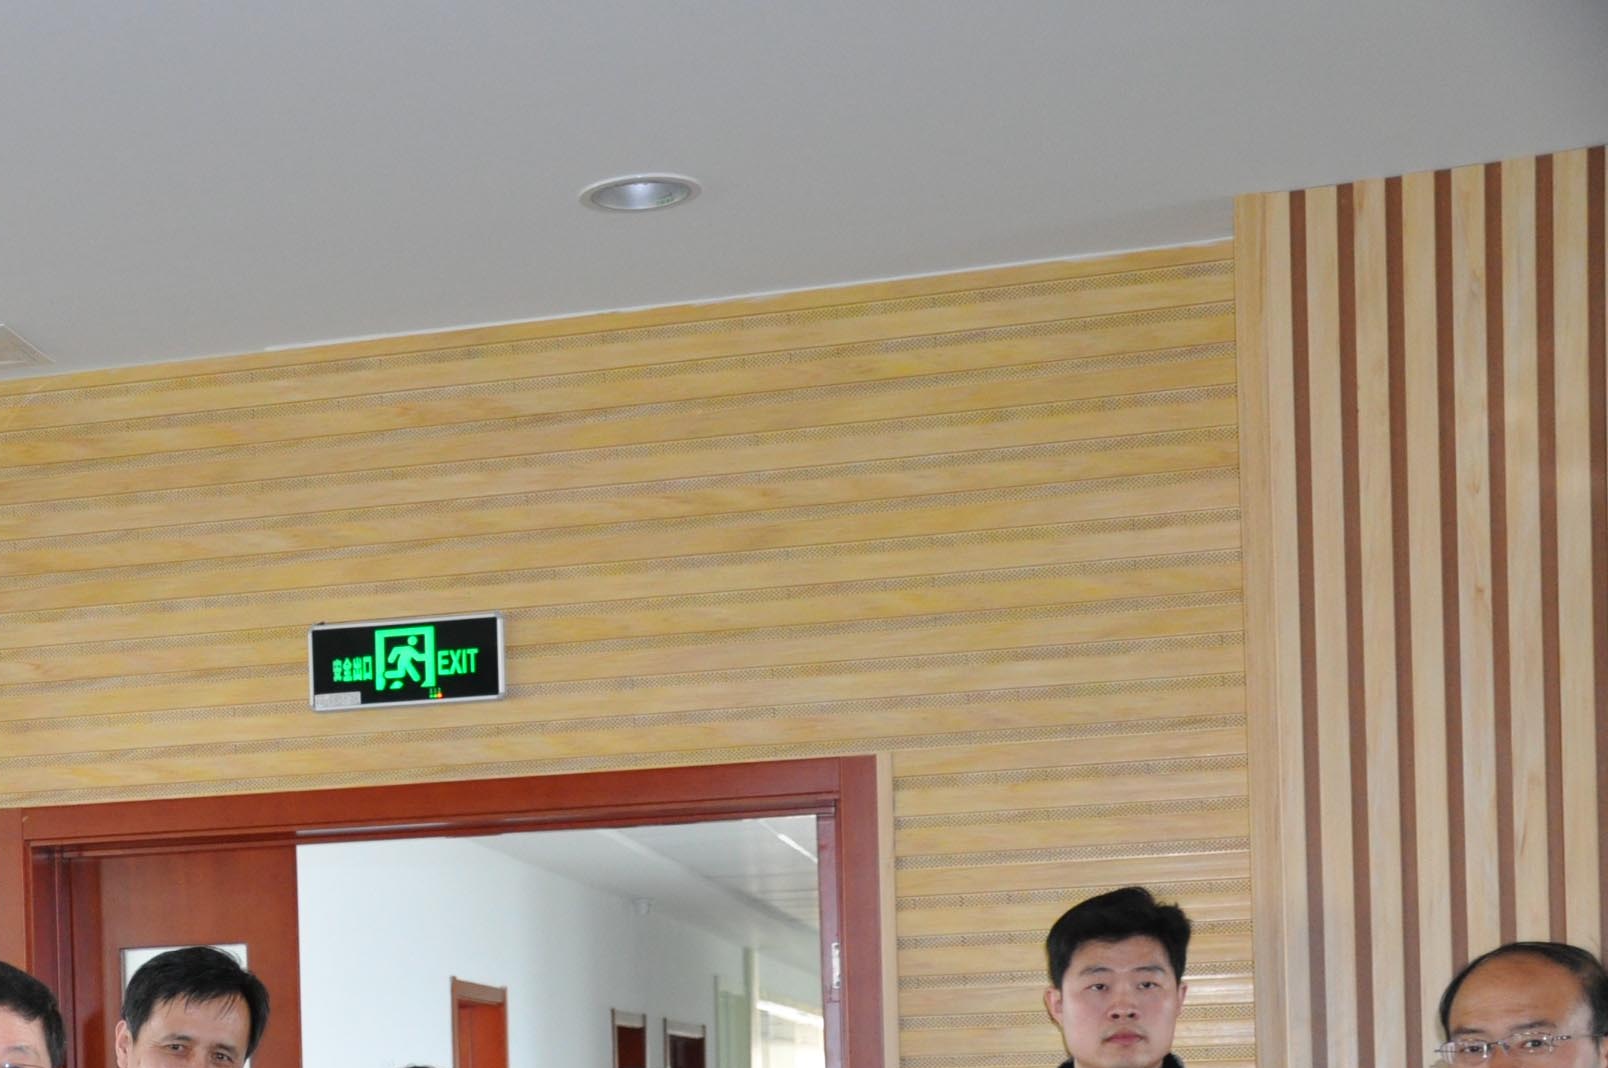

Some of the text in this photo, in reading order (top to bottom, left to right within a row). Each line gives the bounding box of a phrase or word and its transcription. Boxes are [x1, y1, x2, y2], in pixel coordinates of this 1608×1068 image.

[332, 656, 373, 682] 安全出口
[437, 648, 479, 676] EXIT
